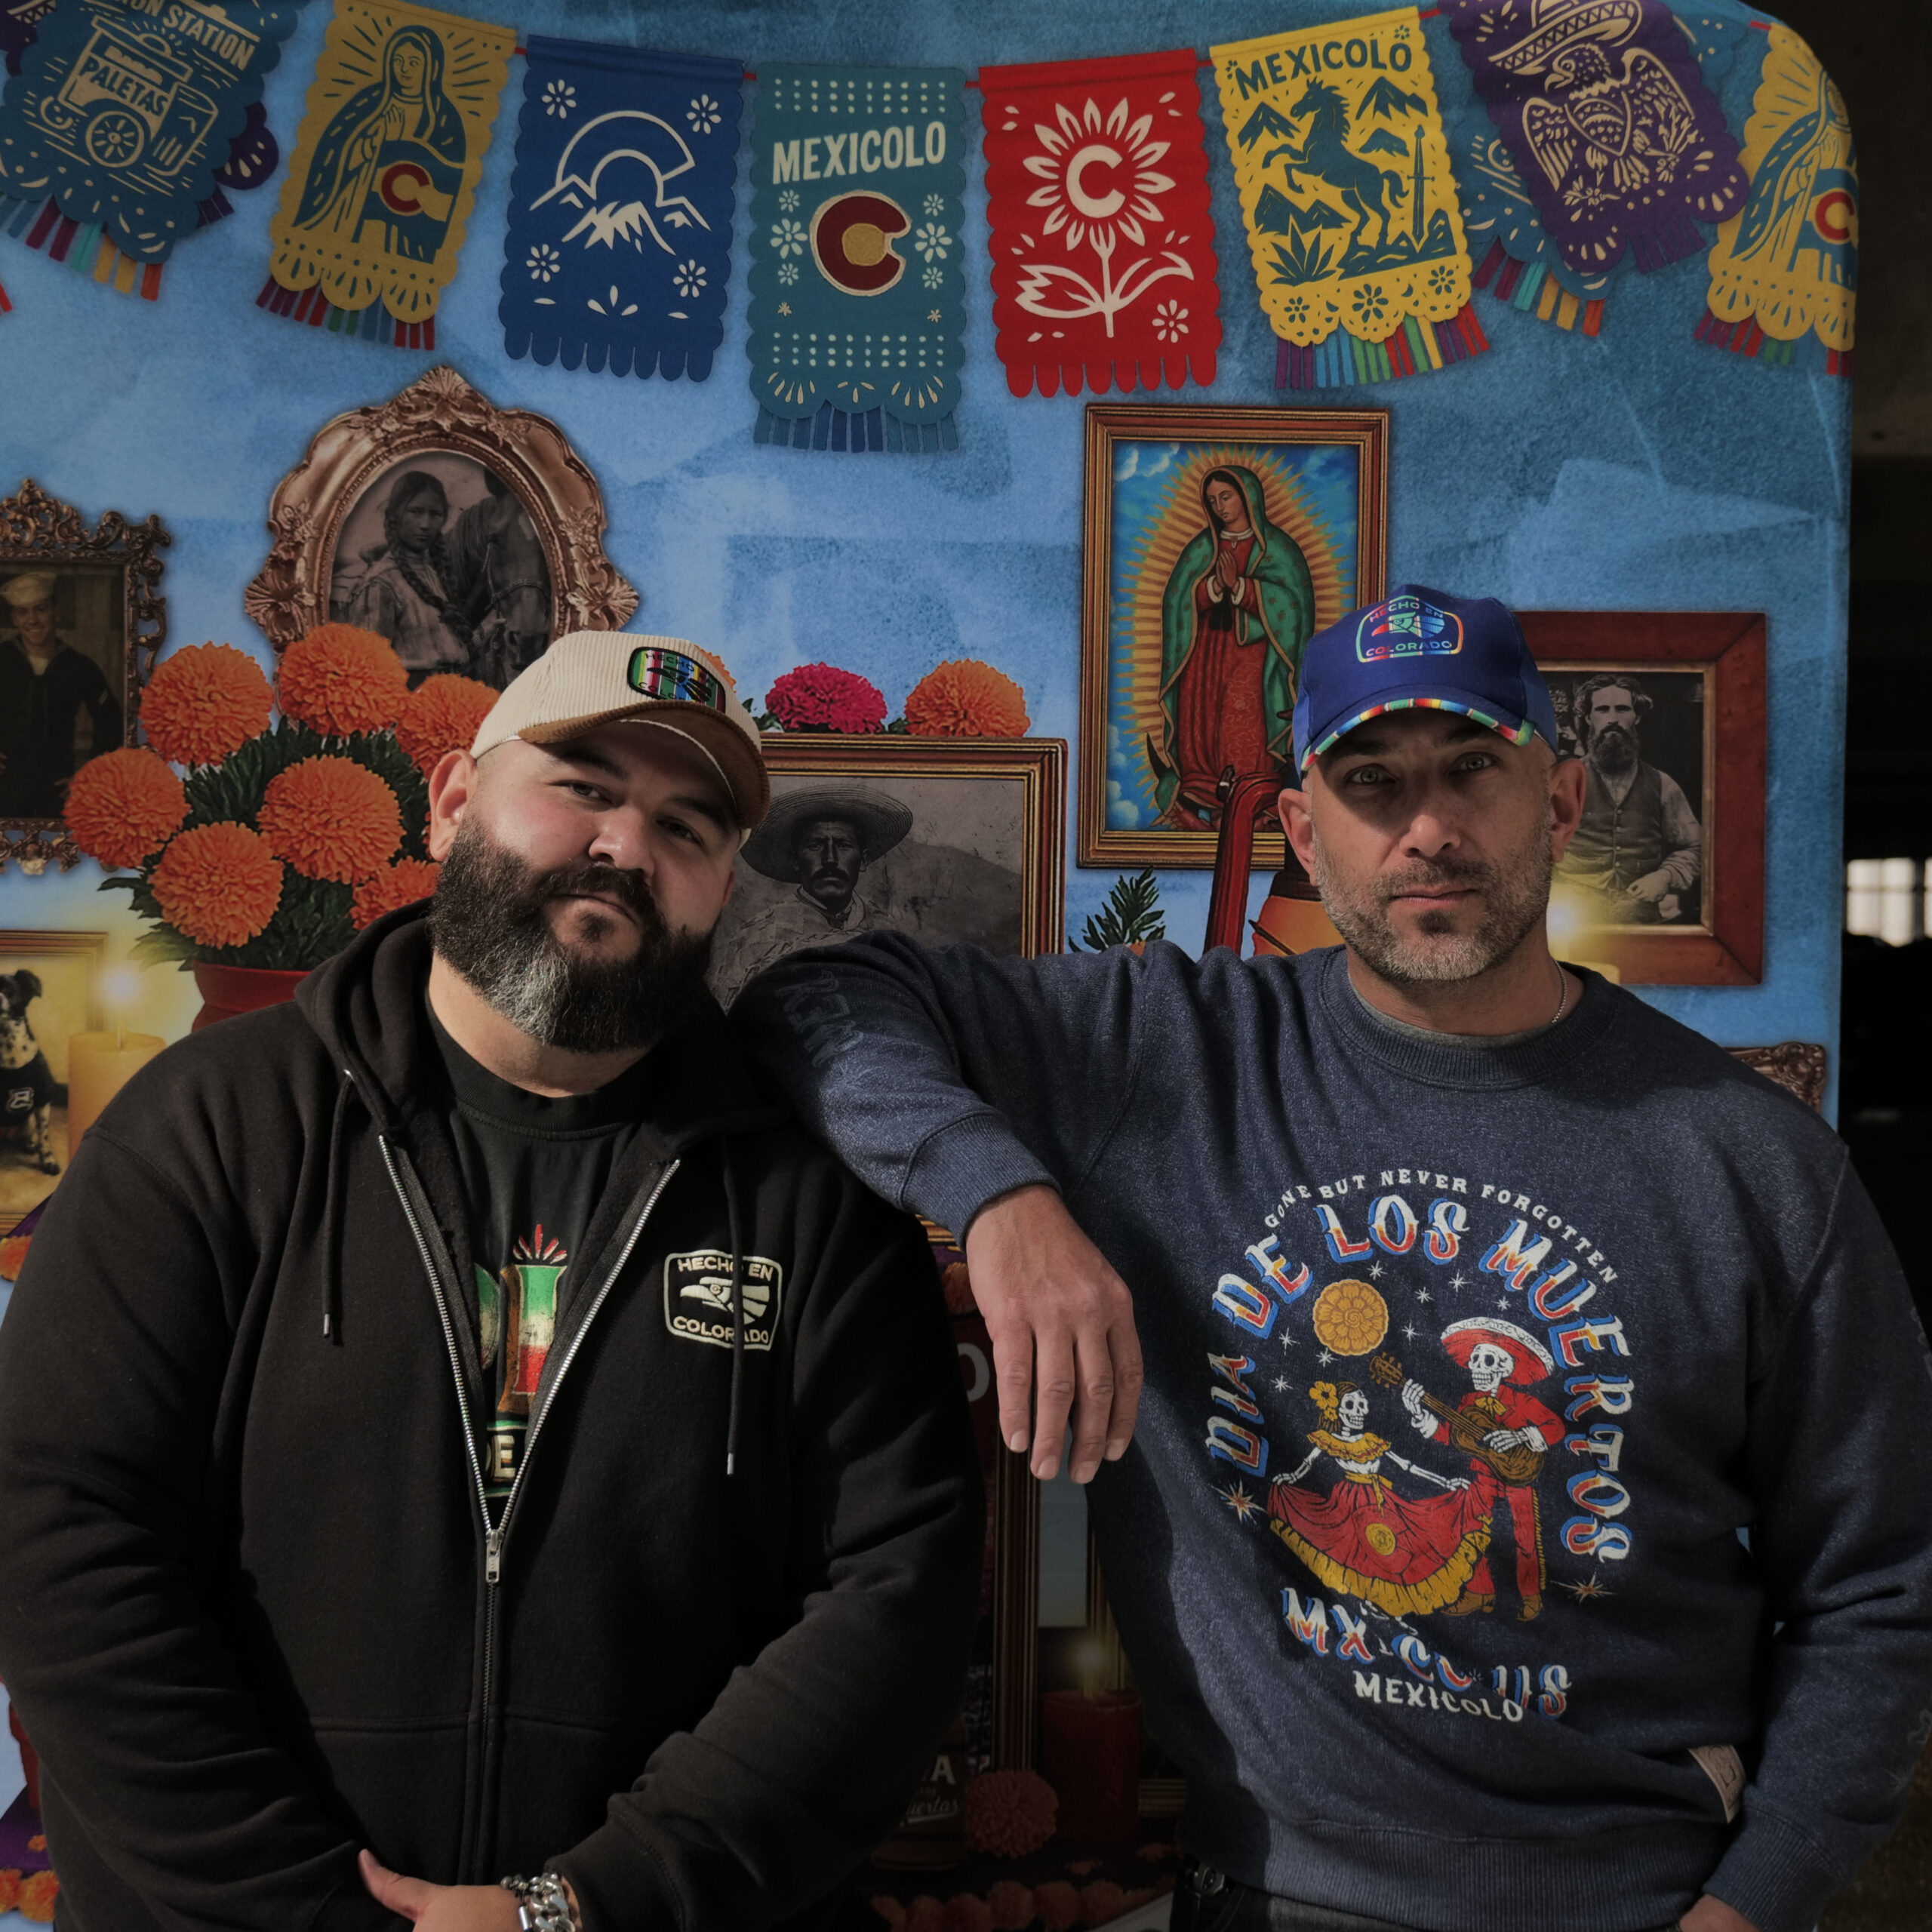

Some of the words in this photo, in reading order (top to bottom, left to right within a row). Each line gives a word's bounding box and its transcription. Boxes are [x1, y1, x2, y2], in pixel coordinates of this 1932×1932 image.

[163, 4, 256, 72] STATION
[1235, 38, 1412, 101] MEXICOLO
[79, 56, 168, 116] PALETAS
[772, 121, 947, 184] MEXICOLO
[1066, 145, 1126, 218] C
[809, 189, 912, 297] C
[1370, 601, 1420, 623] HECHO
[1425, 607, 1444, 619] EN
[645, 653, 695, 672] HECHO
[1365, 640, 1453, 657] COLORADO
[638, 681, 685, 700] COLO
[1264, 1185, 1312, 1228] GONE
[1318, 1175, 1366, 1198] BUT
[1380, 1168, 1468, 1194] NEVER
[1481, 1184, 1618, 1283] FORGOTTEN
[1312, 1194, 1470, 1266] LOS
[748, 1263, 774, 1281] EN
[1211, 1233, 1314, 1340] DE
[1205, 1352, 1269, 1478] DIA
[1478, 1218, 1634, 1563] MUERTOS
[1353, 1670, 1524, 1722] MEXICOLO
